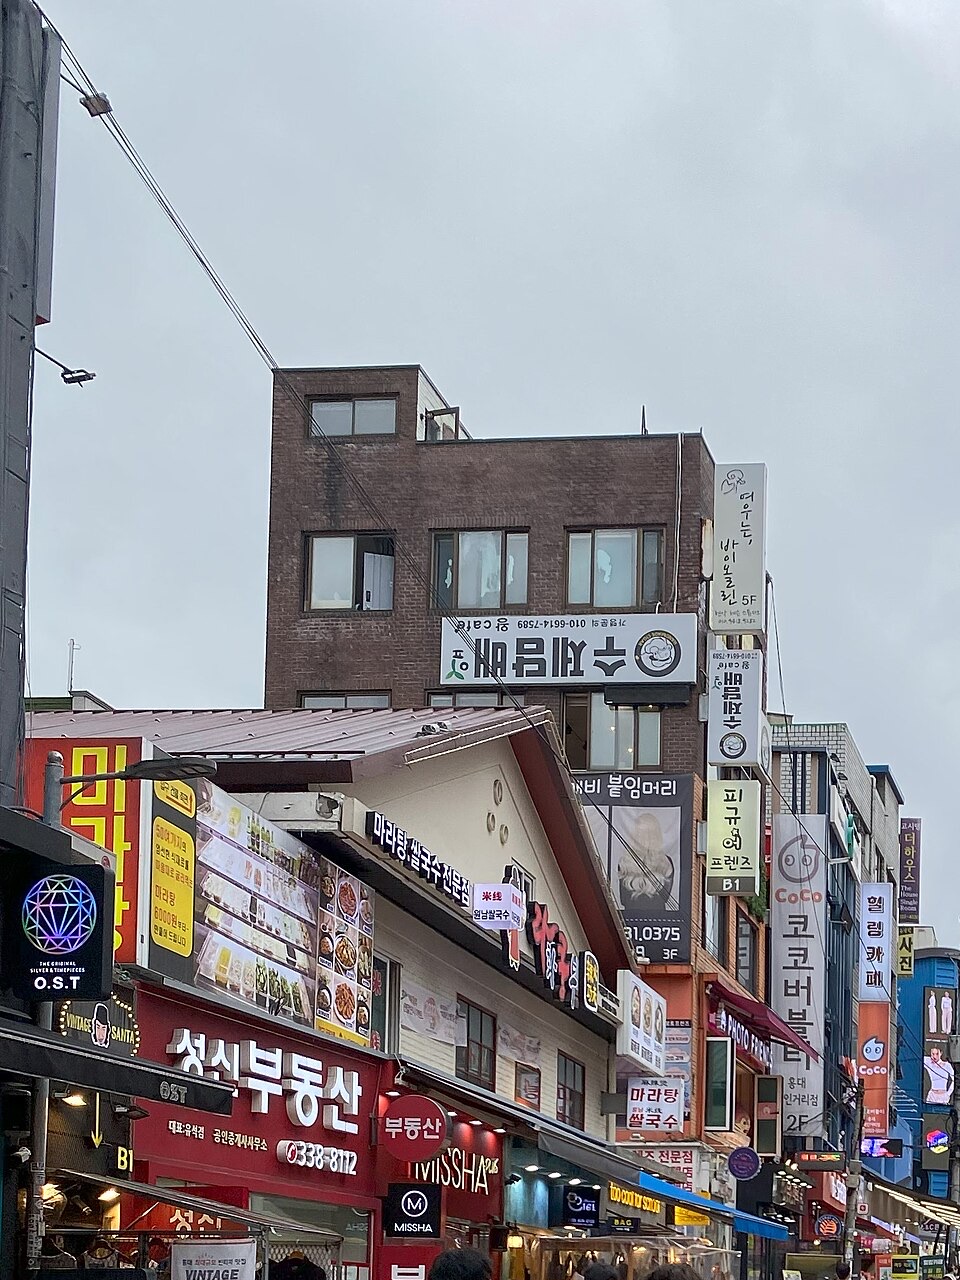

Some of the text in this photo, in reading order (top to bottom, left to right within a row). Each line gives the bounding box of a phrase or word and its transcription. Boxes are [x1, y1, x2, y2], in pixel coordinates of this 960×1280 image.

[720, 539, 738, 605] 바이올린
[742, 595, 756, 605] 5F
[517, 619, 586, 629] 010-6614-7589
[722, 671, 743, 729] 수제담배
[607, 775, 677, 799] 붙임머리
[723, 788, 742, 850] 피규어
[70, 745, 131, 951] 마라
[710, 856, 752, 870] 프렌즈
[904, 833, 916, 883] 더하우스
[722, 879, 740, 891] B1
[155, 888, 176, 907] 마라탕
[663, 949, 678, 959] 3F
[899, 937, 913, 971] 사진
[34, 976, 80, 989] O.S.T
[66, 1013, 135, 1044] VINTAGE SANTA
[728, 1014, 749, 1050] PHOTO
[860, 1065, 887, 1075] CoCo
[631, 1087, 679, 1103] 마라탕
[385, 1117, 442, 1141] 부동산
[629, 1113, 679, 1129] 쌀국수
[787, 1115, 808, 1131] 2F
[117, 1146, 134, 1172] B1
[297, 1141, 357, 1175] 338-8112
[659, 1150, 693, 1164] 전문점
[414, 1148, 489, 1195] MISSHA
[394, 1222, 433, 1233] MISSHA
[185, 1269, 240, 1280] VINTAGE
